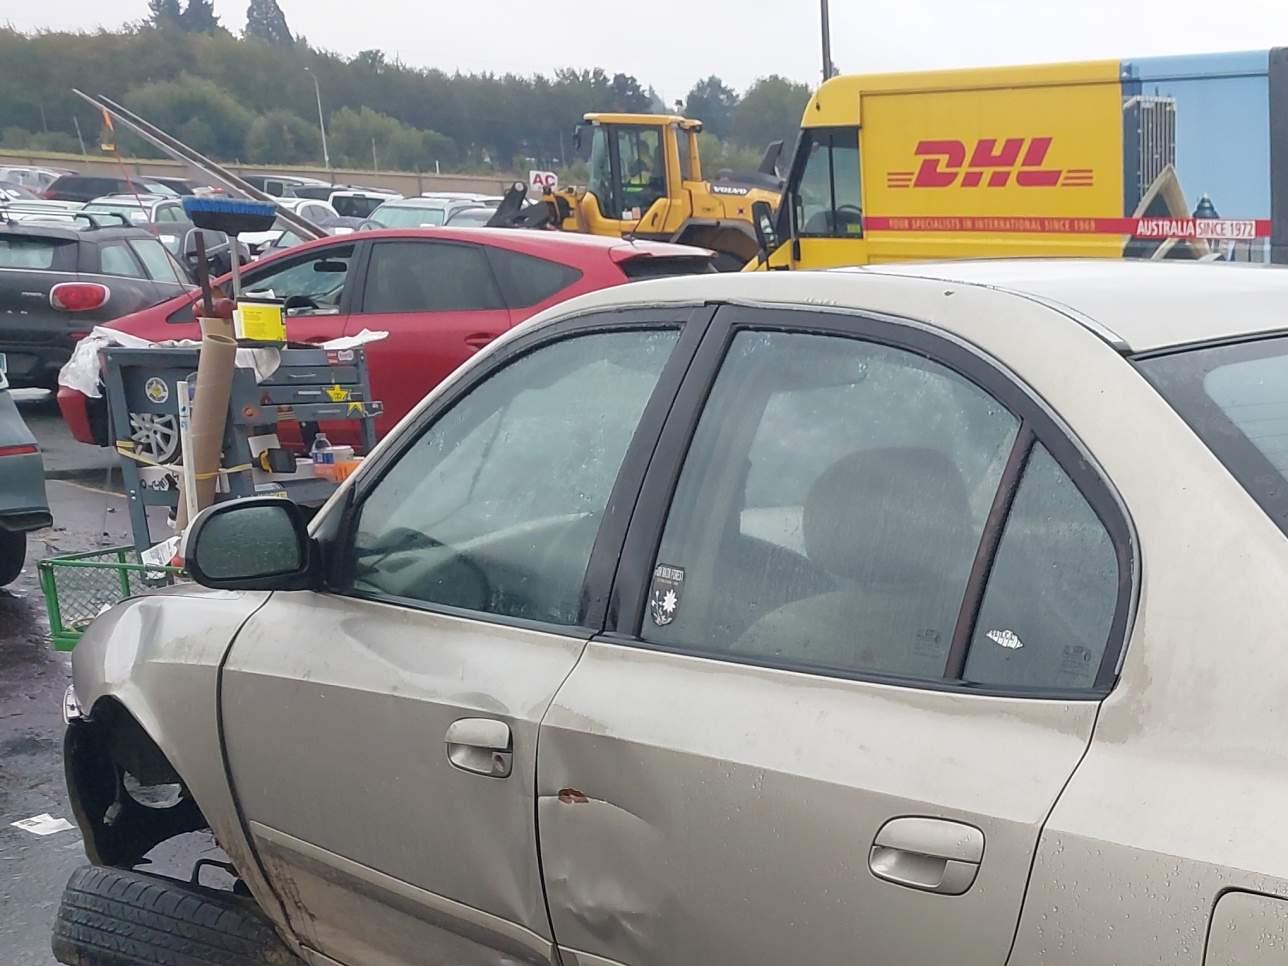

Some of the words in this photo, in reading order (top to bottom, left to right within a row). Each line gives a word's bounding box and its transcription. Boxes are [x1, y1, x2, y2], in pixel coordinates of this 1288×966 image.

[912, 136, 1063, 188] DHL
[532, 173, 556, 187] AC
[713, 185, 748, 195] VOLVO
[911, 218, 959, 230] SPECIALISTS
[962, 219, 972, 230] IN
[975, 219, 1041, 231] INTERNATIONAL
[1044, 219, 1071, 232] SINCE
[1136, 219, 1195, 236] AUSTRALIA
[1199, 220, 1227, 236] SINCE
[1230, 221, 1254, 237] 1972
